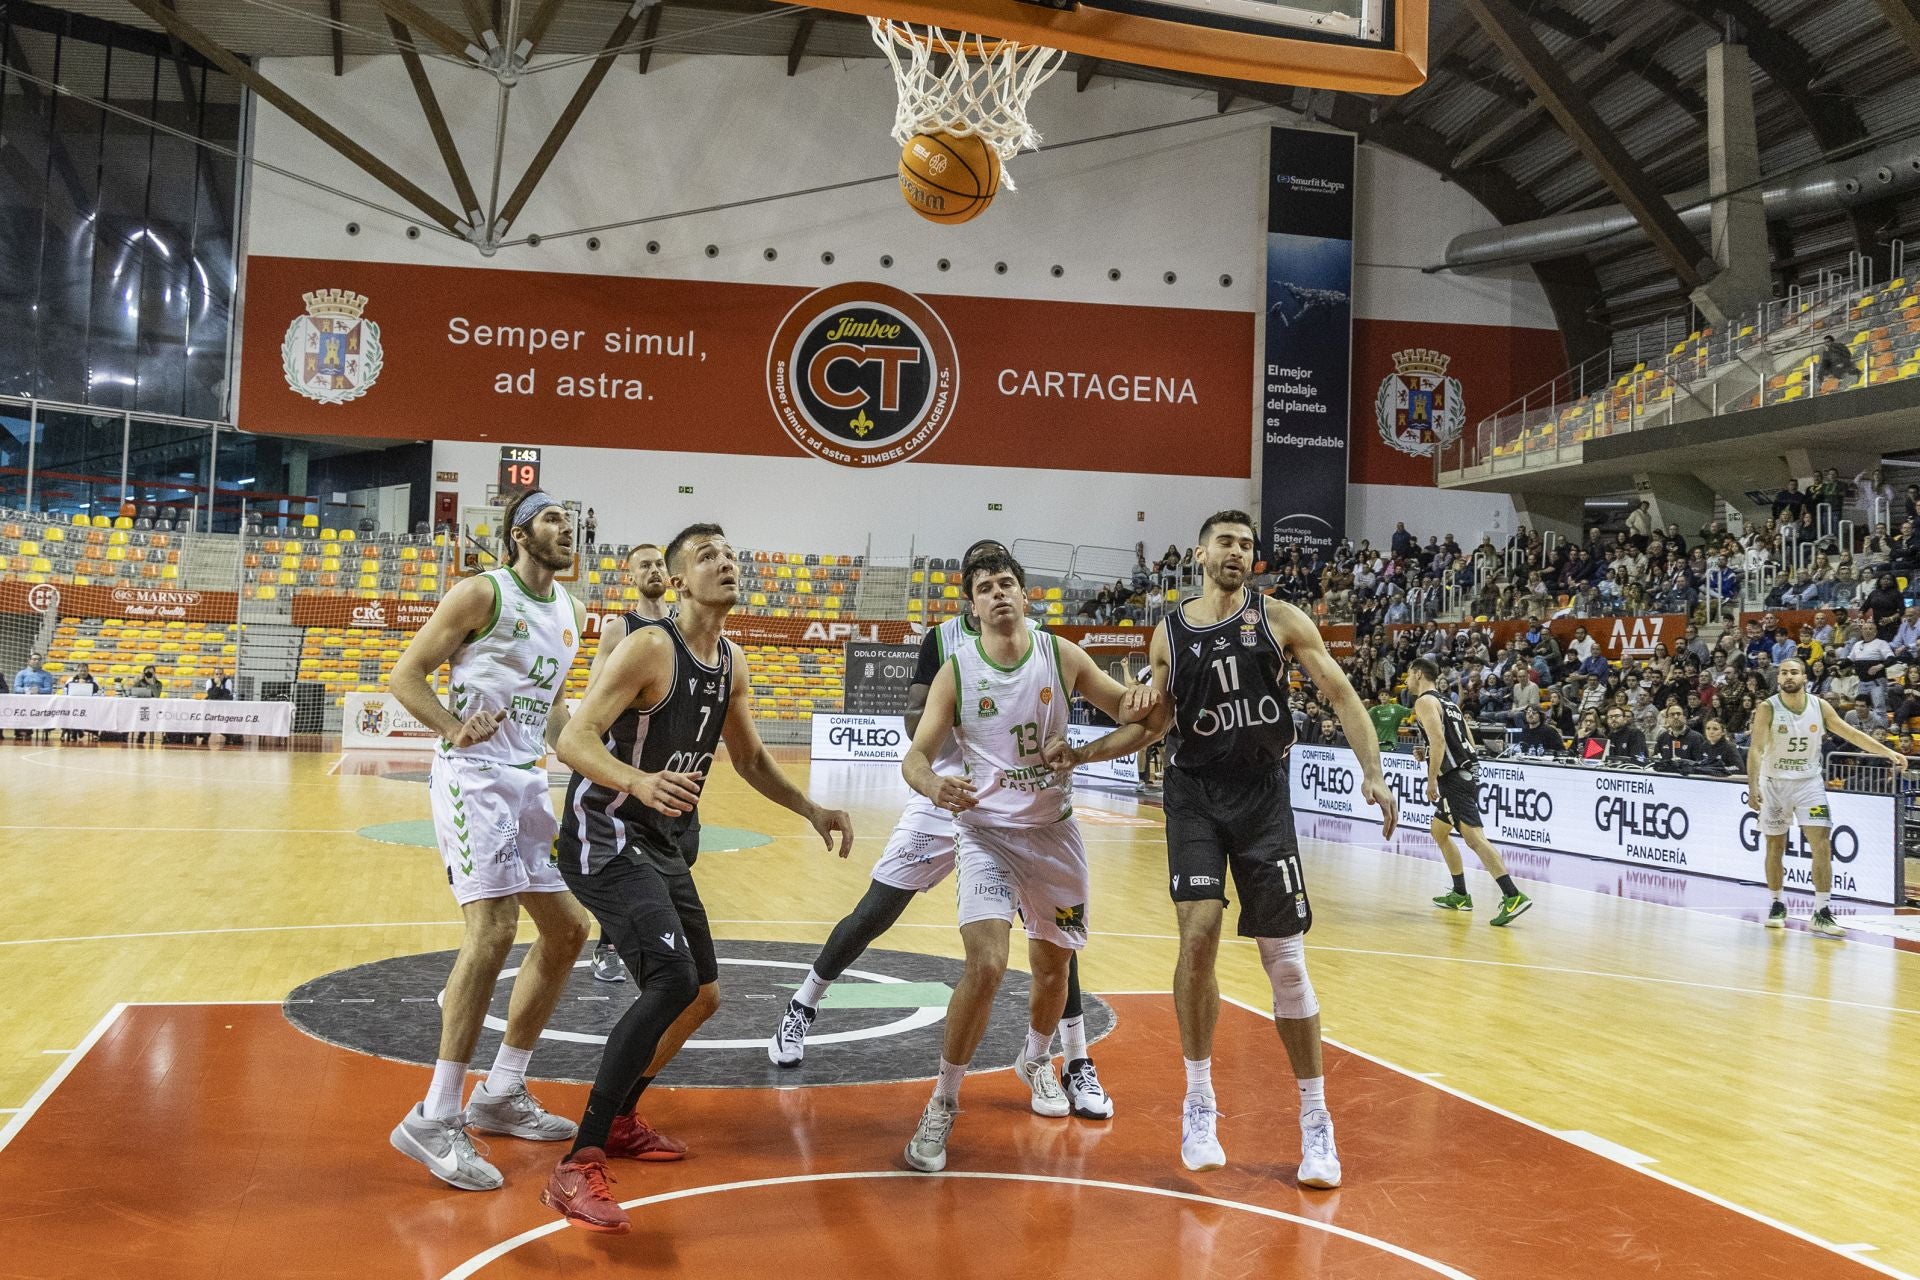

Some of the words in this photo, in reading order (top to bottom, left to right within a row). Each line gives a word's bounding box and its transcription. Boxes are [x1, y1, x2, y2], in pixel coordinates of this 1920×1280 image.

[1290, 176, 1320, 186] Smurfit
[1320, 179, 1345, 191] Kappa
[827, 317, 901, 341] Jimbee
[447, 316, 585, 355] Semper
[604, 327, 706, 362] simul,
[808, 342, 920, 412] CT
[1268, 364, 1279, 376] El
[1280, 366, 1312, 380] mejor
[494, 368, 535, 395] ad
[556, 373, 654, 401] astra.
[998, 368, 1198, 404] CARTAGENA
[1268, 382, 1318, 396] embalaje
[776, 360, 788, 405] semper
[784, 406, 808, 440] simul,
[806, 434, 822, 450] ad
[822, 448, 851, 463] astra
[861, 446, 905, 464] JIMBEE
[904, 391, 948, 451] CARTAGENA
[940, 367, 950, 388] F.S.
[1267, 398, 1284, 411] del
[1286, 400, 1327, 414] planeta
[1267, 417, 1280, 427] es
[1266, 432, 1344, 448] biodegradable
[510, 449, 538, 462] 1:43
[508, 464, 536, 485] 19
[1274, 534, 1302, 544] Better
[1304, 536, 1332, 546] Planet
[136, 592, 194, 603] MARNYS
[352, 607, 386, 620] CRC
[1088, 634, 1144, 643] MASEGO
[854, 650, 876, 658] ODILO
[528, 656, 559, 690] 42
[884, 664, 915, 678] ODIL
[1212, 656, 1240, 693] 11
[30, 708, 70, 718] Cartagena
[511, 696, 550, 714] AMICS
[204, 714, 243, 723] Cartagena
[696, 706, 711, 742] 7
[830, 717, 876, 725] CONFITERÍA
[1193, 696, 1280, 736] ODILO
[829, 726, 900, 752] GALLEGO
[1010, 722, 1040, 758] 13
[1788, 737, 1808, 752] 55
[854, 750, 898, 758] PANADERÍA
[1302, 750, 1336, 762] CONFITERÍA
[1383, 757, 1422, 772] CONFITERÍA
[1301, 763, 1354, 800] GALLEGO
[1478, 766, 1524, 782] CONFITERÍA
[1596, 778, 1654, 796] CONFITERÍA
[1318, 798, 1352, 812] PANADERÍA
[1478, 783, 1552, 827] GALLEGO
[1594, 795, 1690, 846] GALLEGO
[1502, 826, 1551, 844] PANADERÍA
[1626, 844, 1688, 866] PANADERÍA
[1276, 856, 1302, 894] 11
